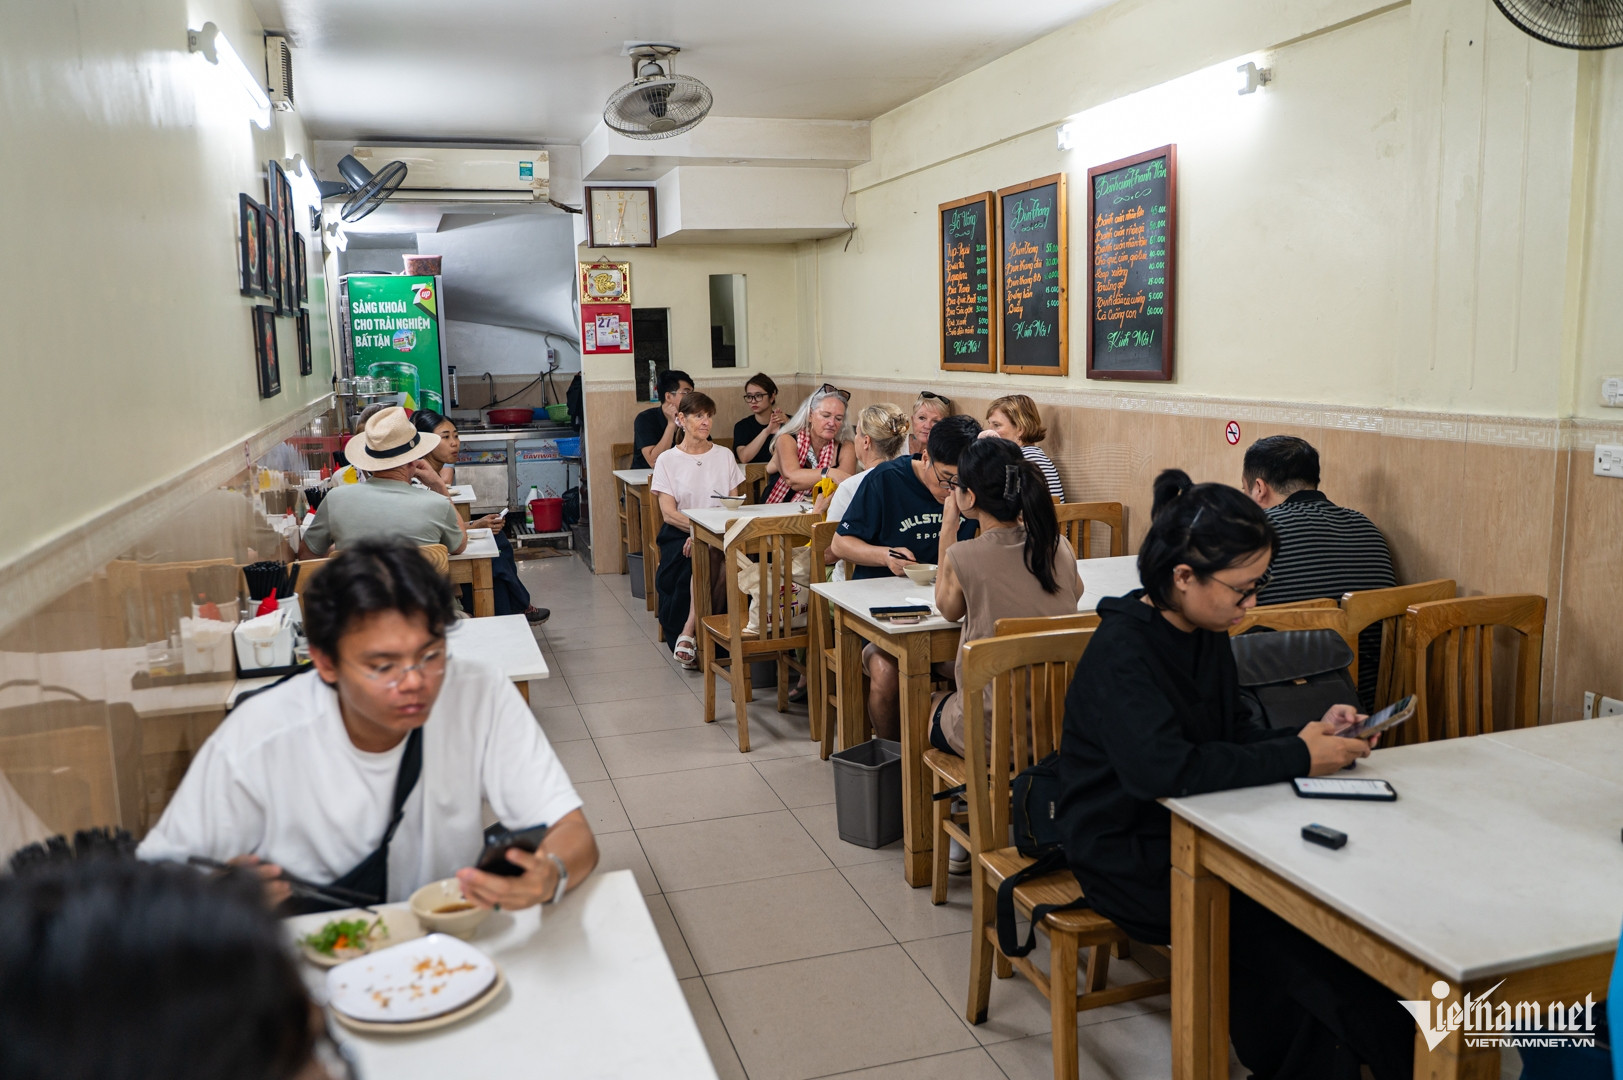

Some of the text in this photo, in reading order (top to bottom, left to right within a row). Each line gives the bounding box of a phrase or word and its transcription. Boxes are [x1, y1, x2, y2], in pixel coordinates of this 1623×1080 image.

[379, 299, 407, 314] KHOÁI
[354, 316, 431, 332] CHO TRẢI NGHIỆM
[598, 317, 611, 328] 27
[355, 333, 373, 348] BẤT
[373, 335, 391, 349] TẬN
[899, 513, 966, 533] JILLSTUT
[916, 531, 941, 540] SPO
